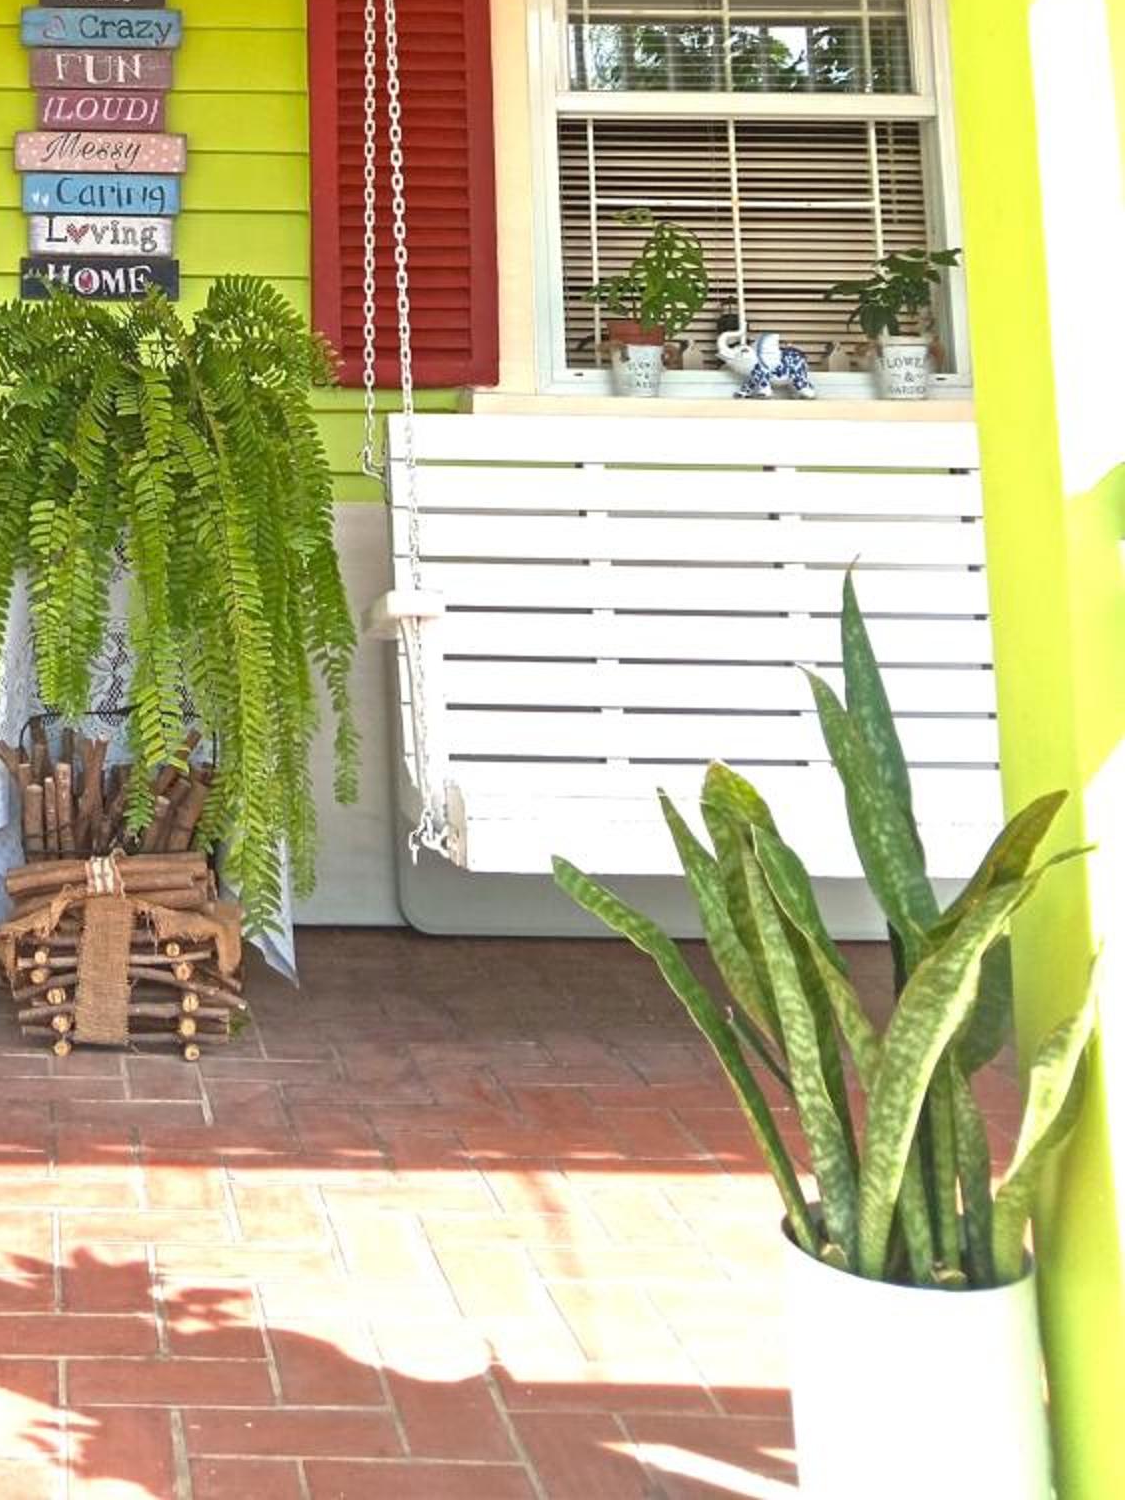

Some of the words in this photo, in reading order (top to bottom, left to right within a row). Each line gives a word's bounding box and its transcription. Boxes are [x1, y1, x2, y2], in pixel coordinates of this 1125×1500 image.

[78, 14, 173, 46] Crazy
[55, 52, 142, 85] FUN
[39, 132, 142, 171] Messy
[56, 177, 166, 215] Caring
